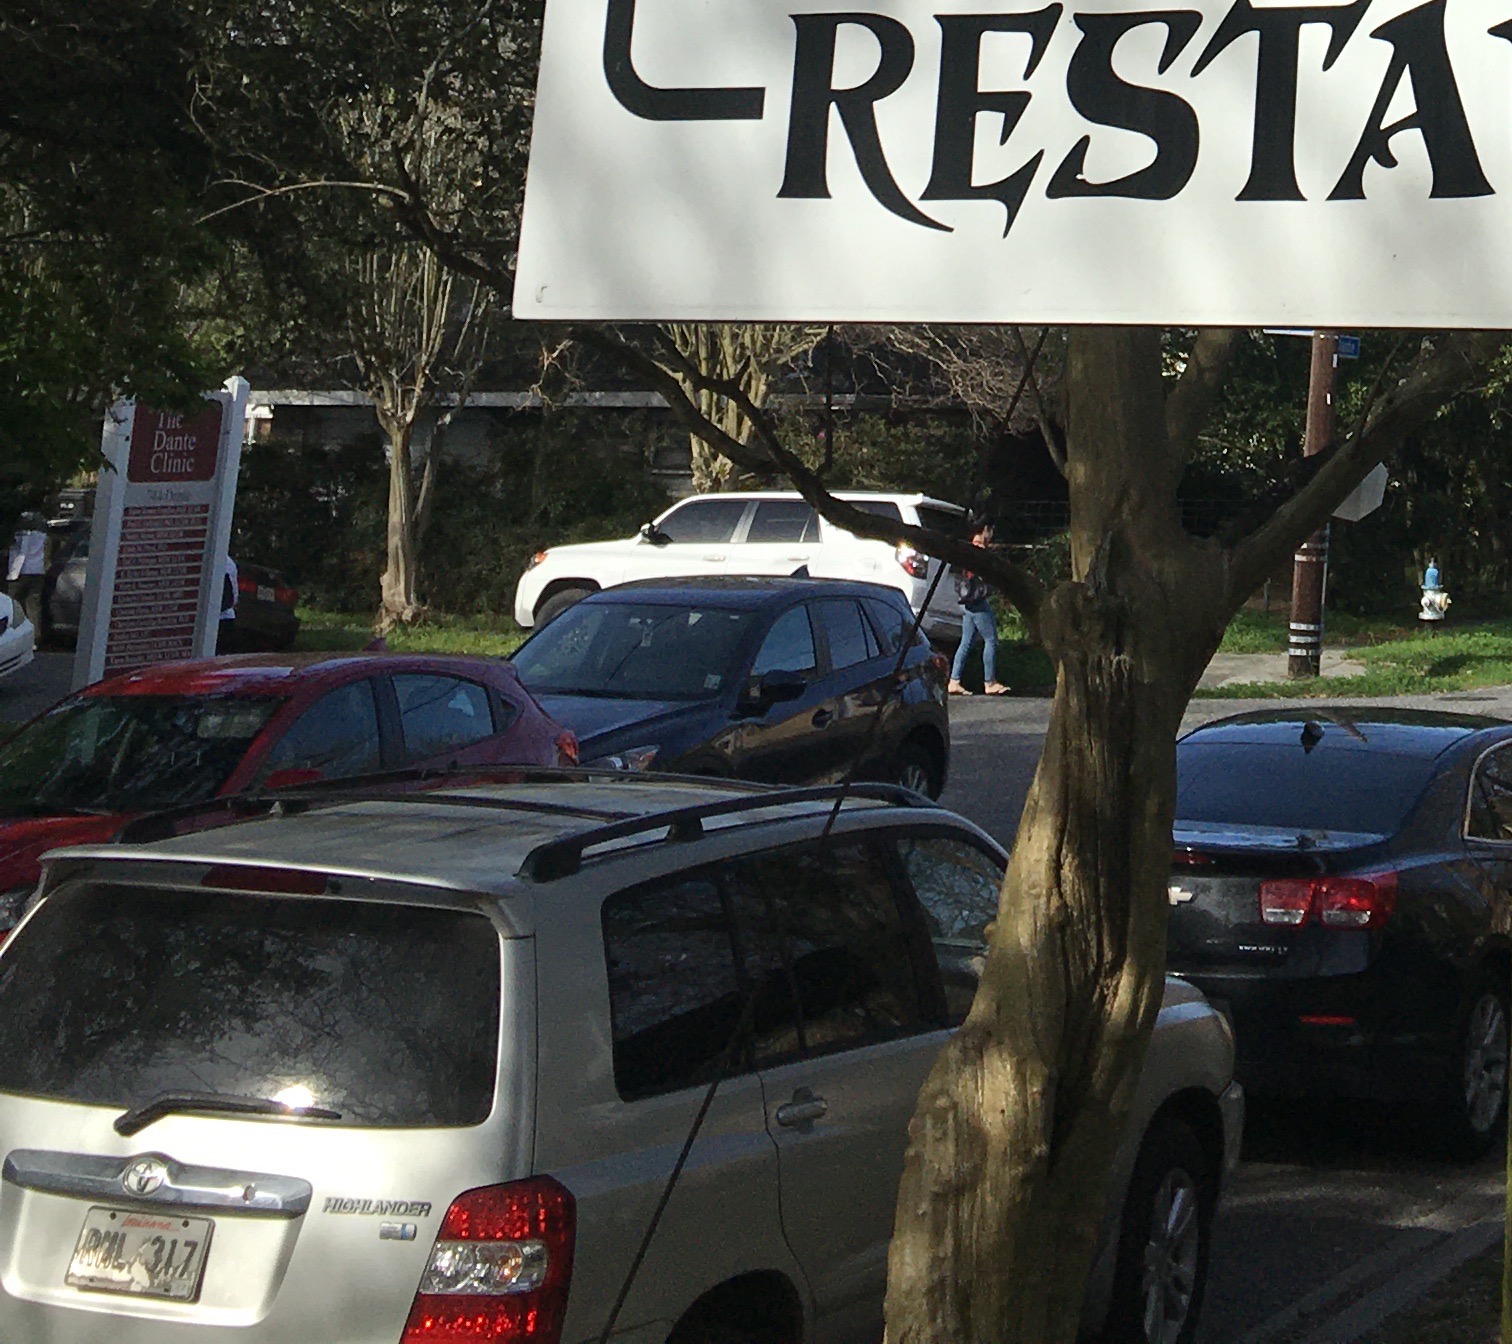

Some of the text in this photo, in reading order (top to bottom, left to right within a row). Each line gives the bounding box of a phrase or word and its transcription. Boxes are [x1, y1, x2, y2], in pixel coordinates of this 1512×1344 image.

[153, 430, 196, 451] Dante
[150, 452, 195, 473] Clinic
[323, 1197, 432, 1218] HIGHLANDER
[148, 1234, 199, 1278] 317
